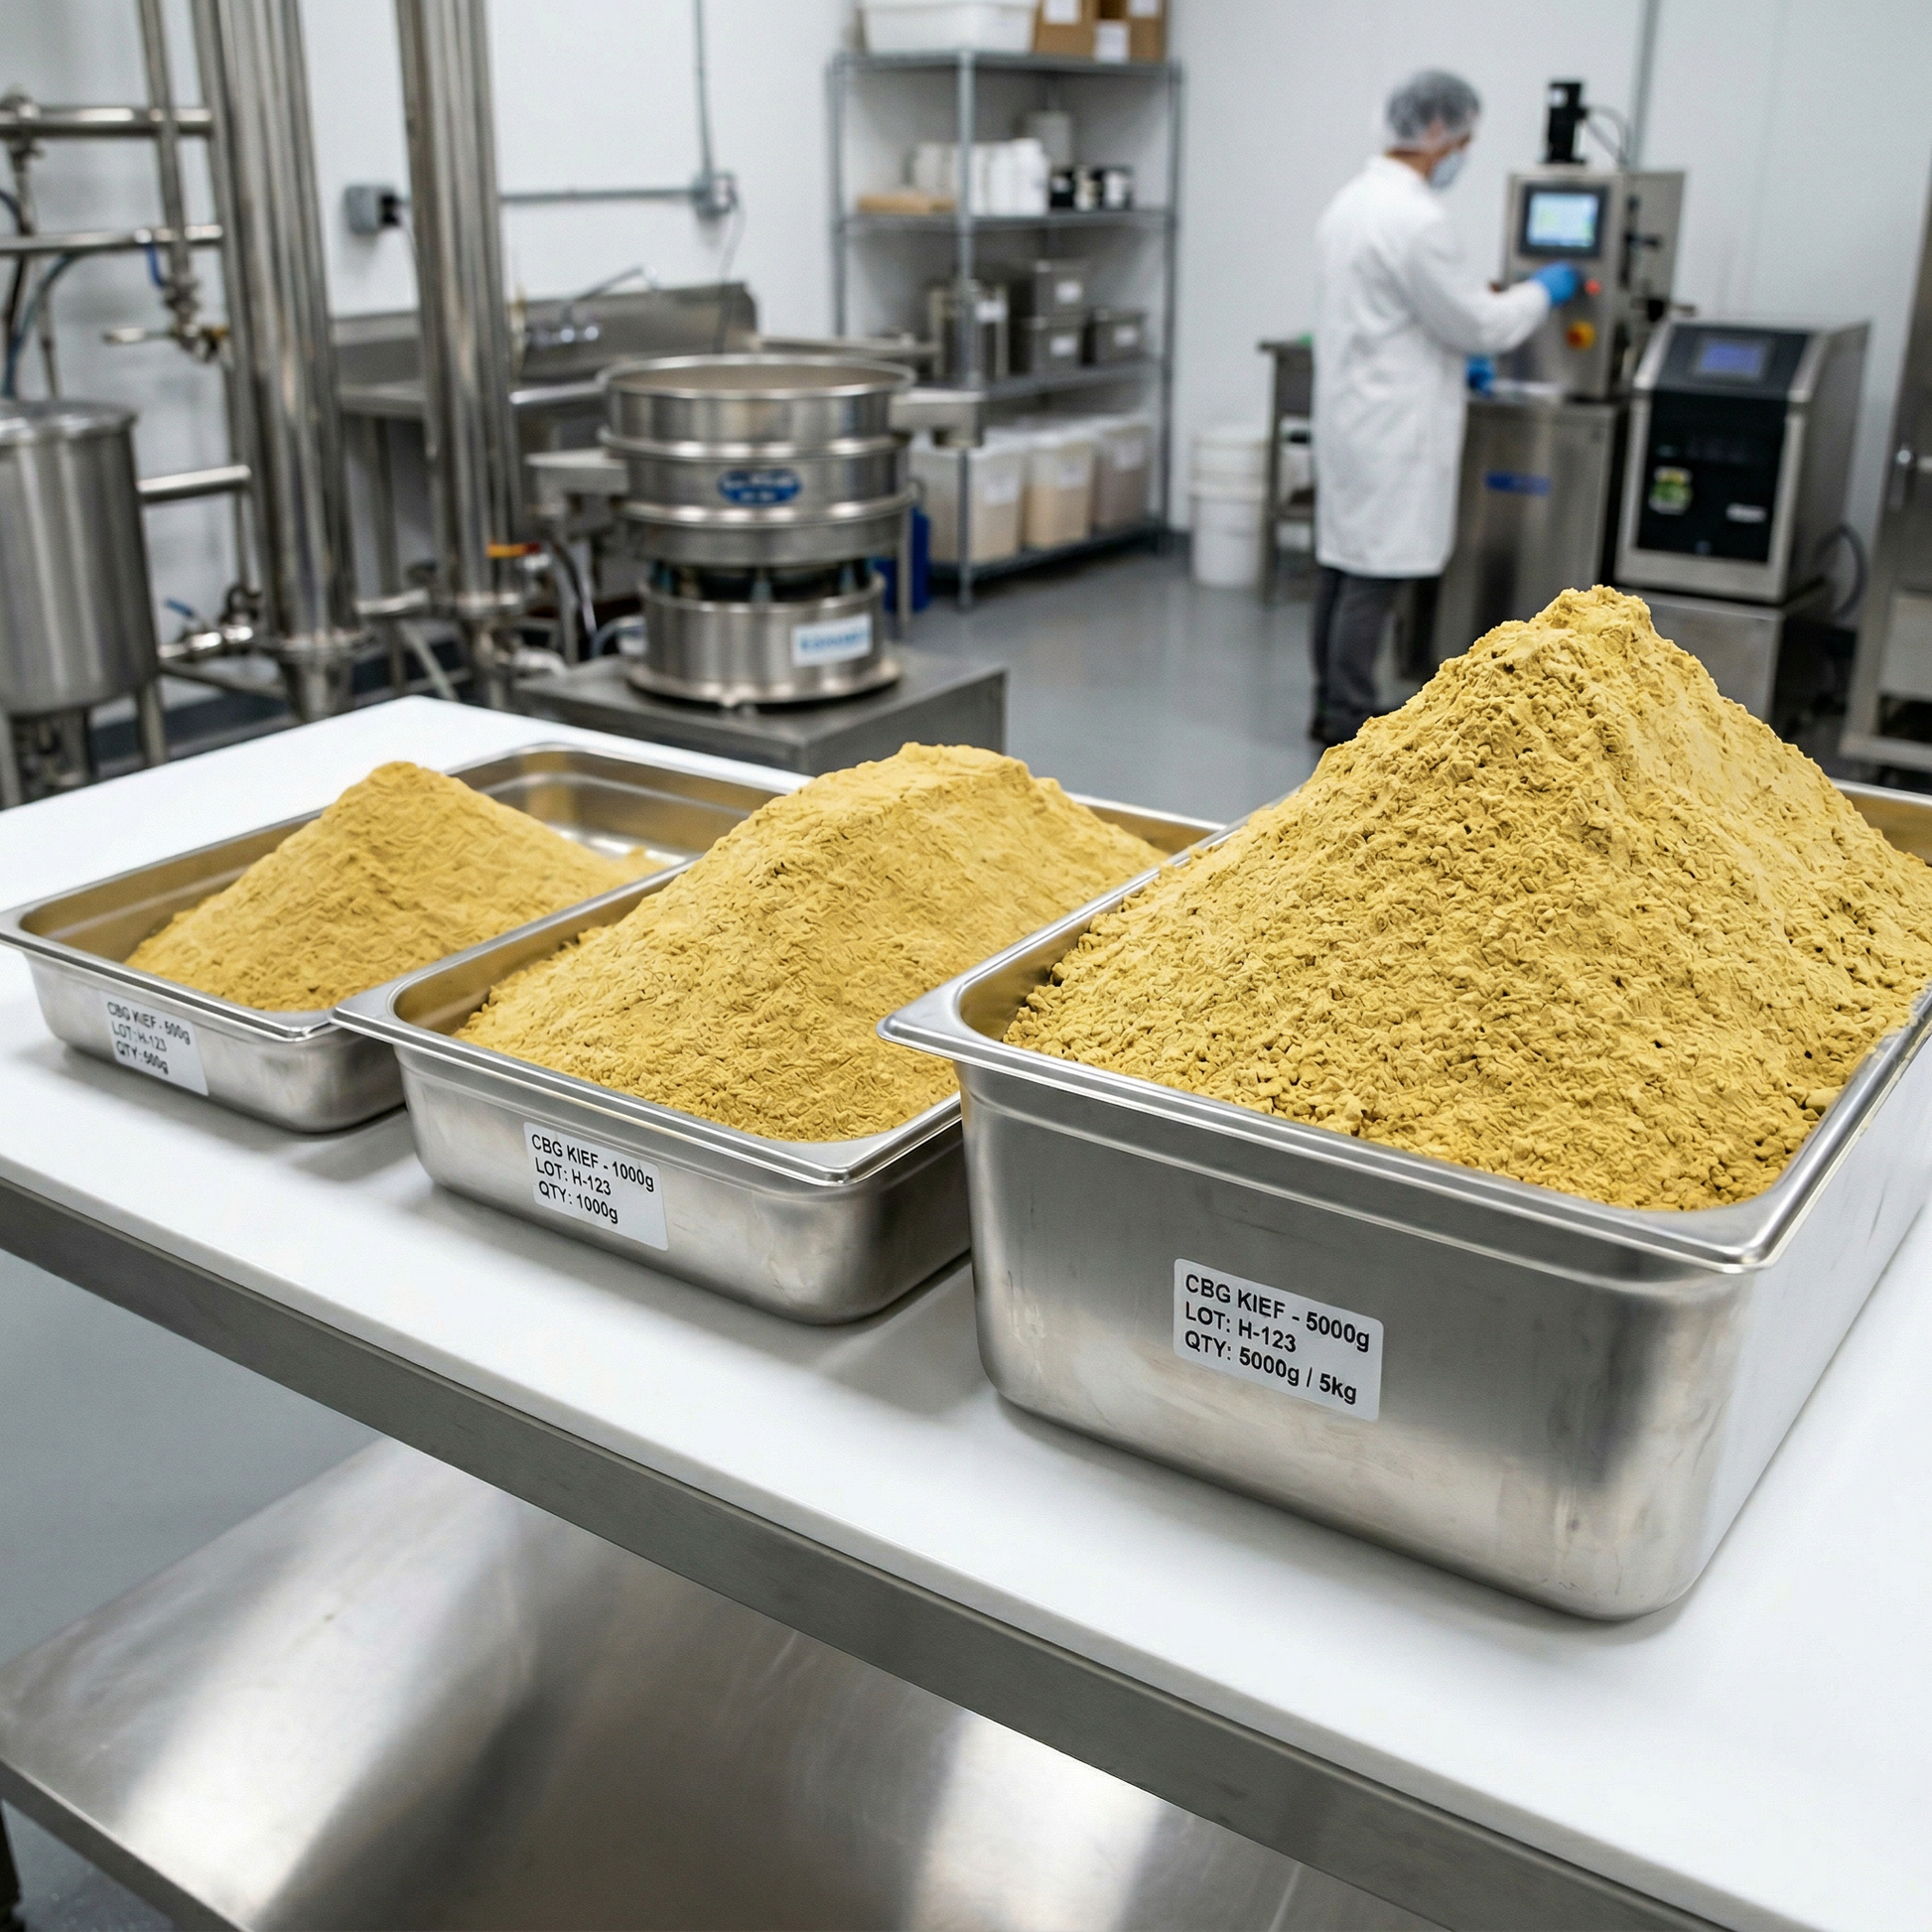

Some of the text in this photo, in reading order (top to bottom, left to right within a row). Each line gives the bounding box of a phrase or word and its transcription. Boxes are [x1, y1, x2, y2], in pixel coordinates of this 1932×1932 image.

[531, 1134, 563, 1158] CBG
[566, 1145, 599, 1169] KIEF
[612, 1161, 654, 1192] 1000g
[534, 1157, 612, 1195] LOT: H-123
[538, 1180, 619, 1224] QTY: 1000g
[1185, 1274, 1231, 1304] CBG
[1237, 1289, 1286, 1319] KIEF
[1306, 1311, 1370, 1353] 5000g
[1185, 1302, 1297, 1352] LOT: H-123
[1184, 1330, 1357, 1405] QTY: 5000g / 5kg
